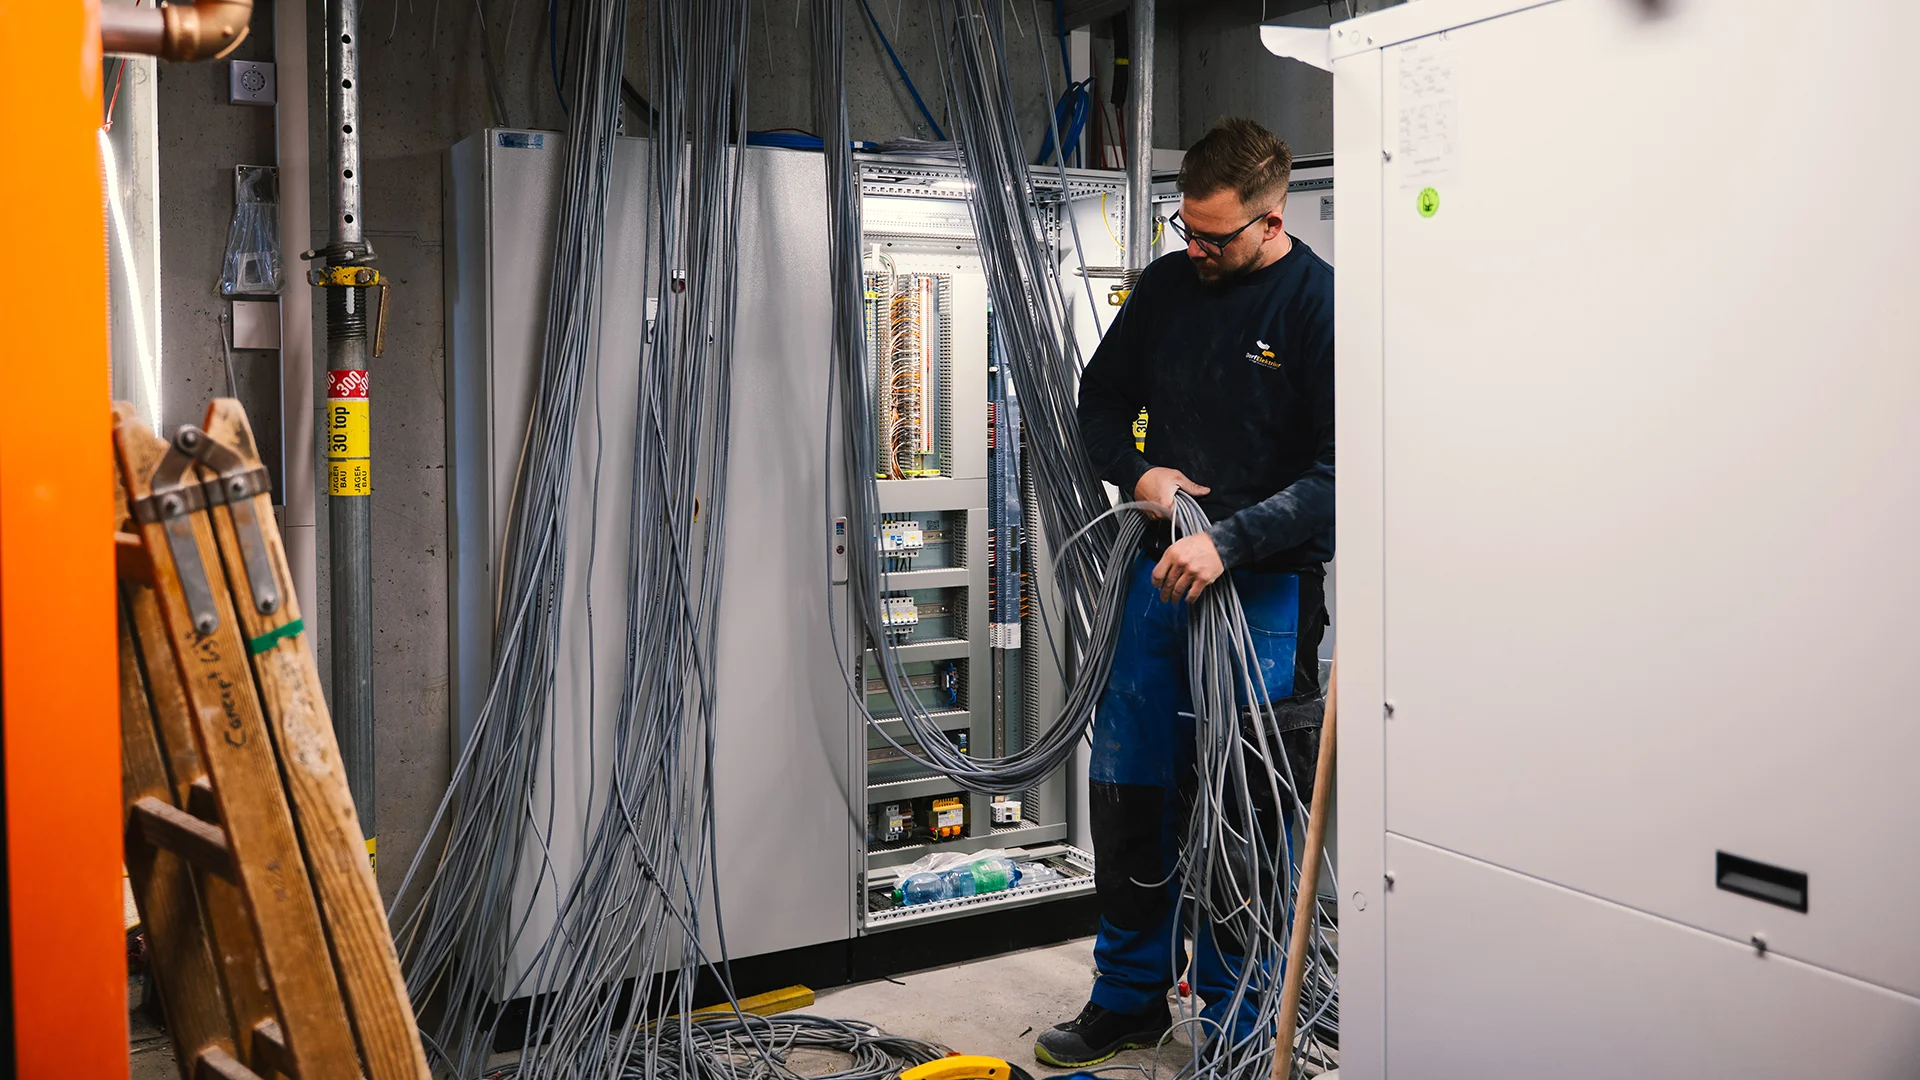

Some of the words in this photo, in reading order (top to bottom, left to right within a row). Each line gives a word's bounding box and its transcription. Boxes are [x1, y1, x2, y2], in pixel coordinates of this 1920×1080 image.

[336, 370, 361, 396] 300
[334, 406, 350, 429] top
[1136, 418, 1148, 433] 30
[332, 434, 347, 452] 30
